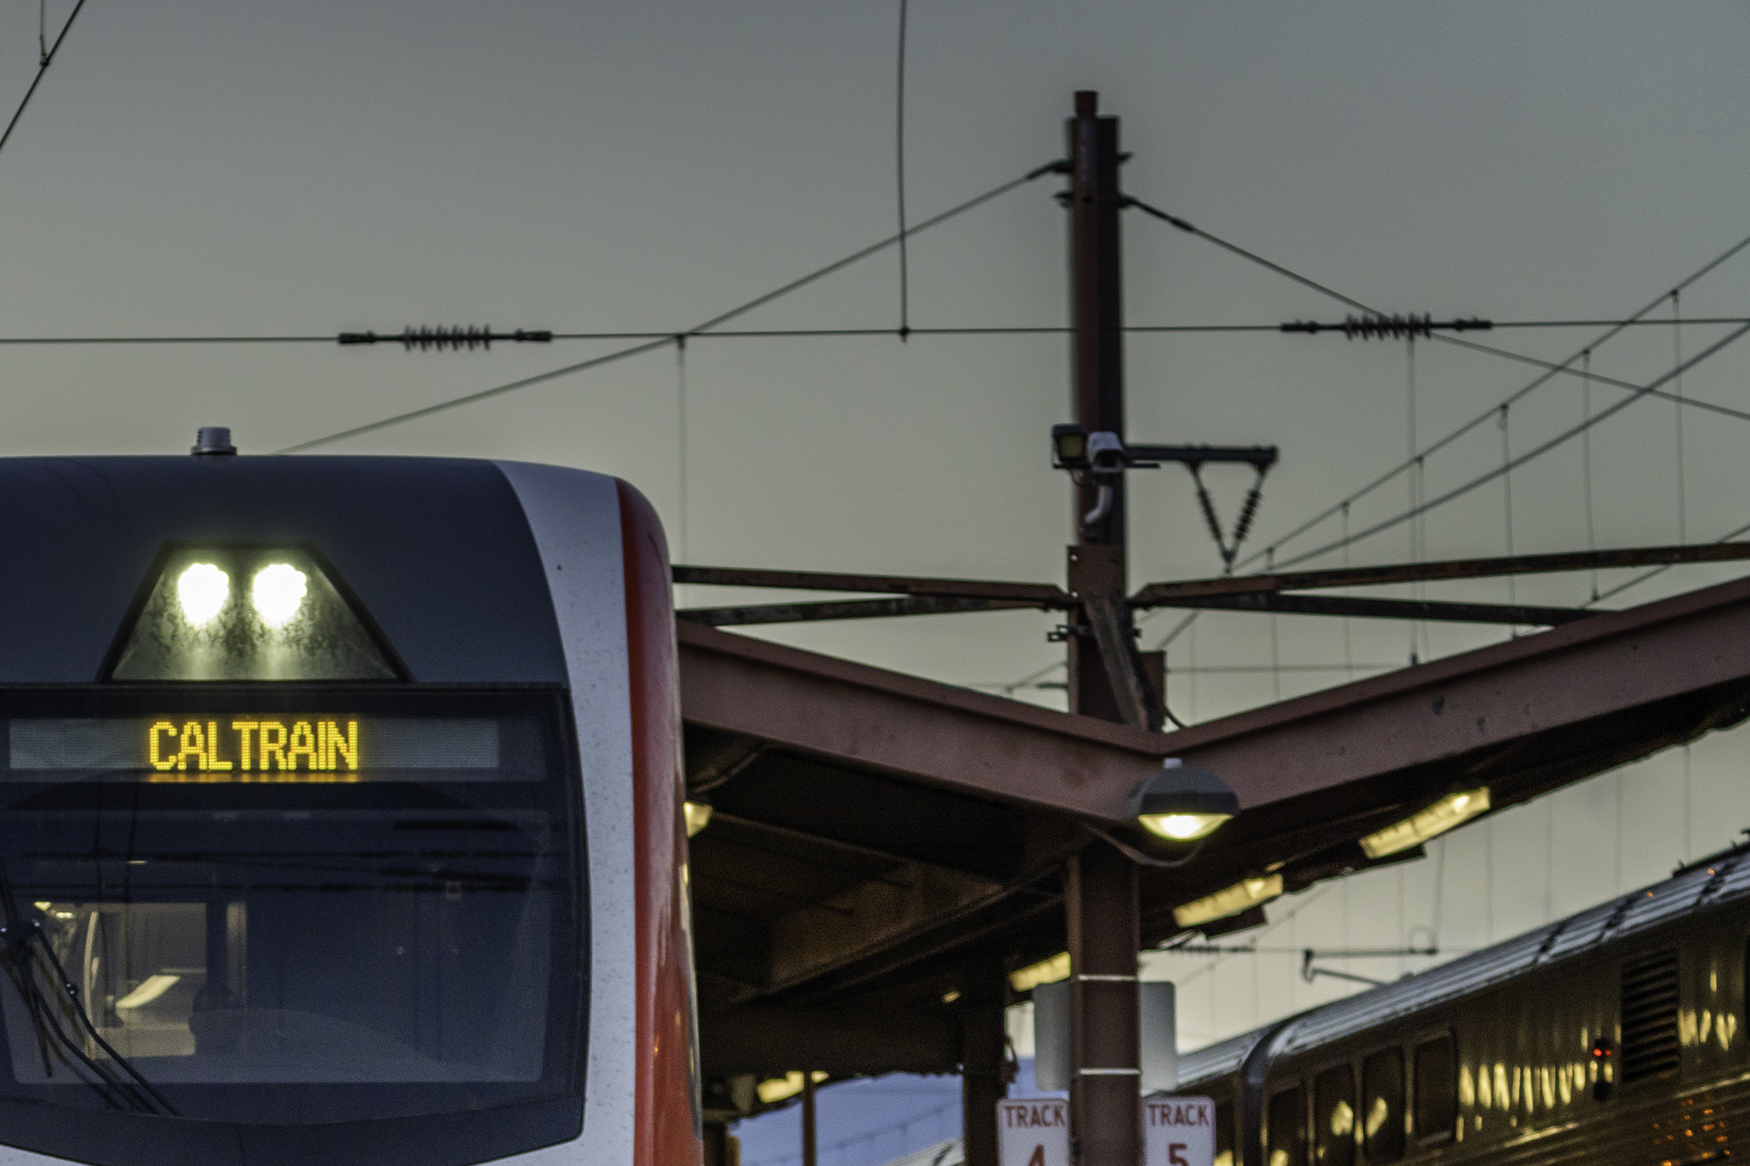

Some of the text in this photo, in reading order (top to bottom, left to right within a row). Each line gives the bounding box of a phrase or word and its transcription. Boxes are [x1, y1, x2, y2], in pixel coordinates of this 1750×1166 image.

[150, 721, 358, 770] CALTRAIN
[1004, 1105, 1066, 1128] TRACK
[1148, 1104, 1209, 1126] TRACK
